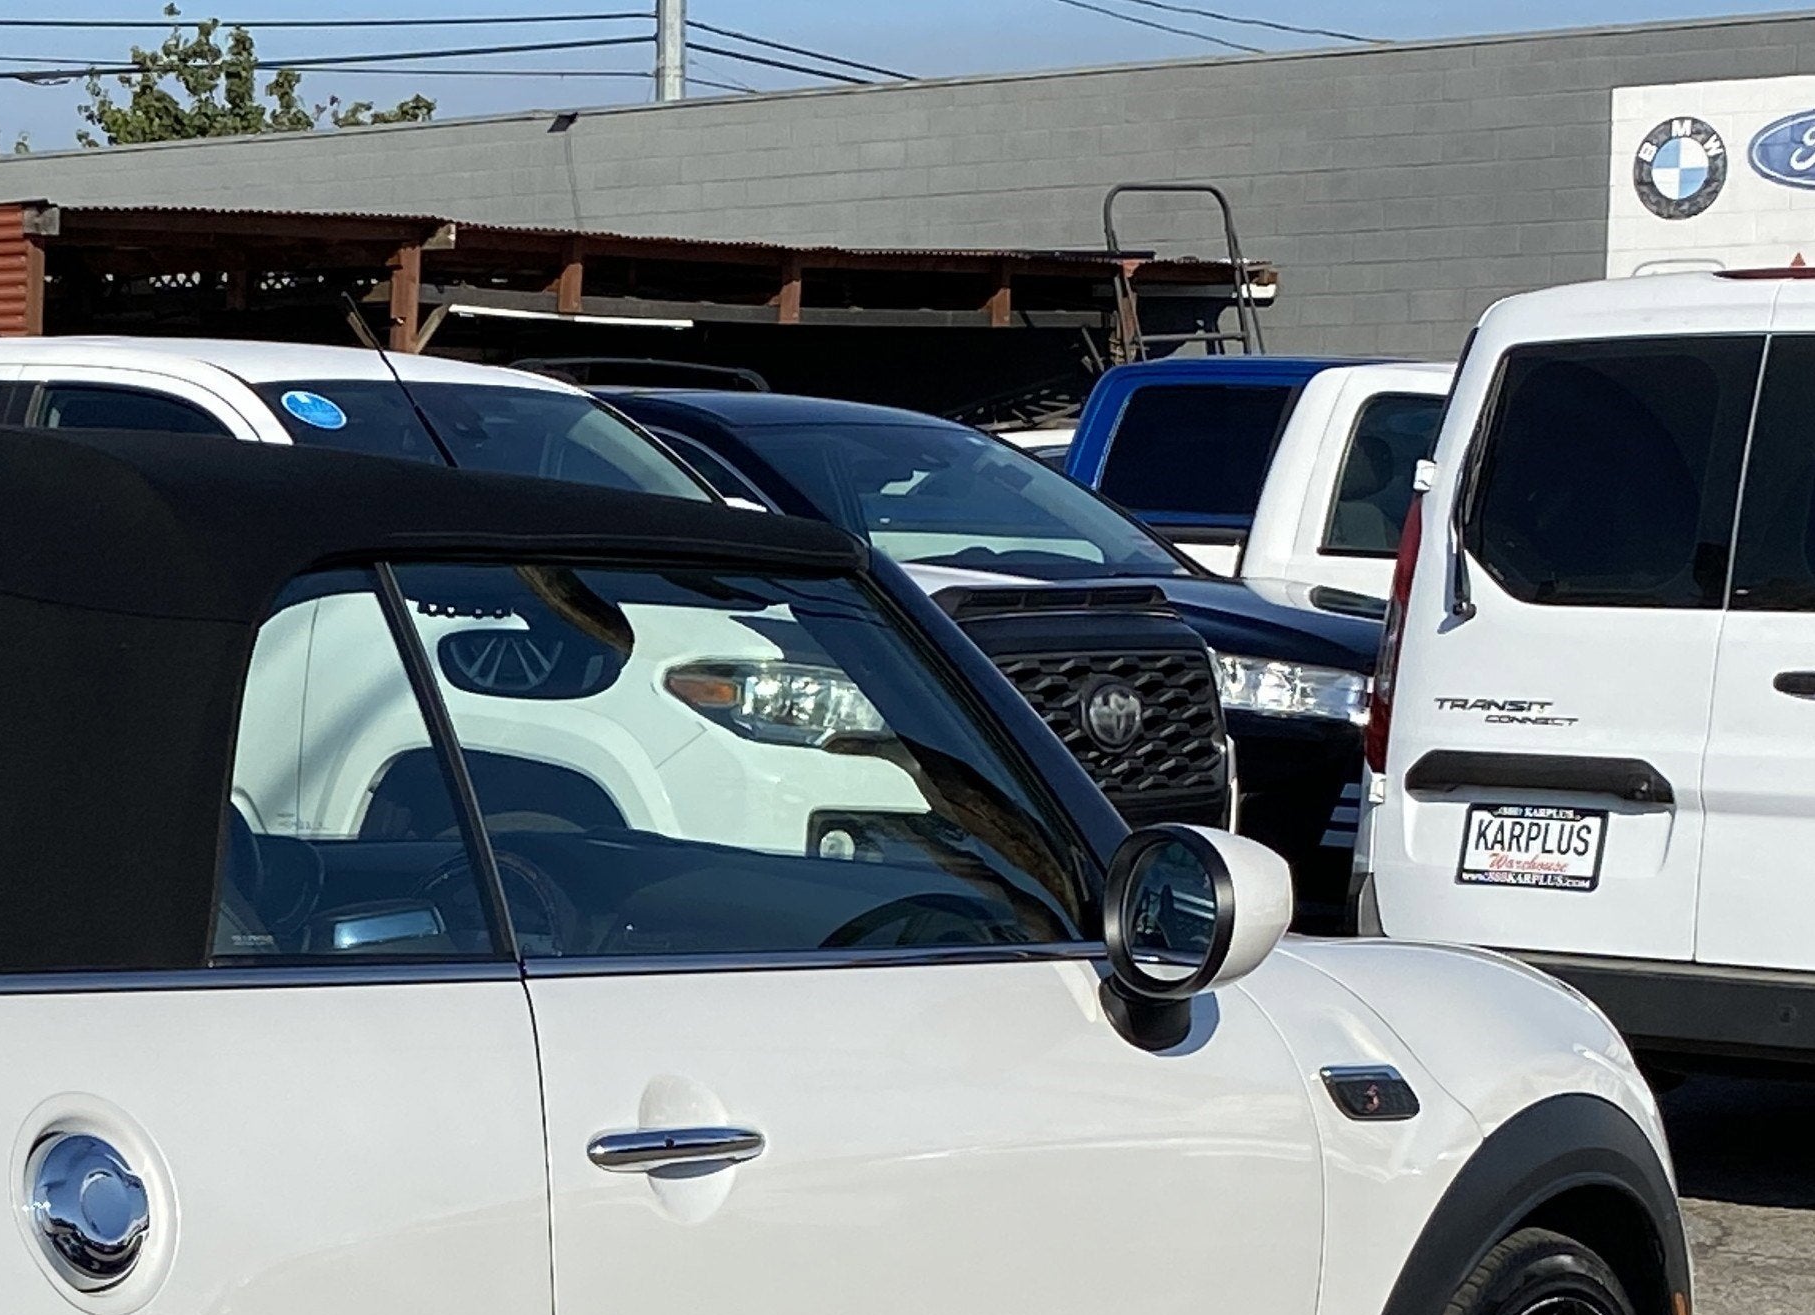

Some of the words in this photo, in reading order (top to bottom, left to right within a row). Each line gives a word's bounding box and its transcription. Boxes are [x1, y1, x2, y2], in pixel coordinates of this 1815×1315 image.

[1638, 119, 1723, 162] BMW
[1434, 697, 1553, 711] TRANSIT
[1474, 819, 1592, 856] KARPLUS
